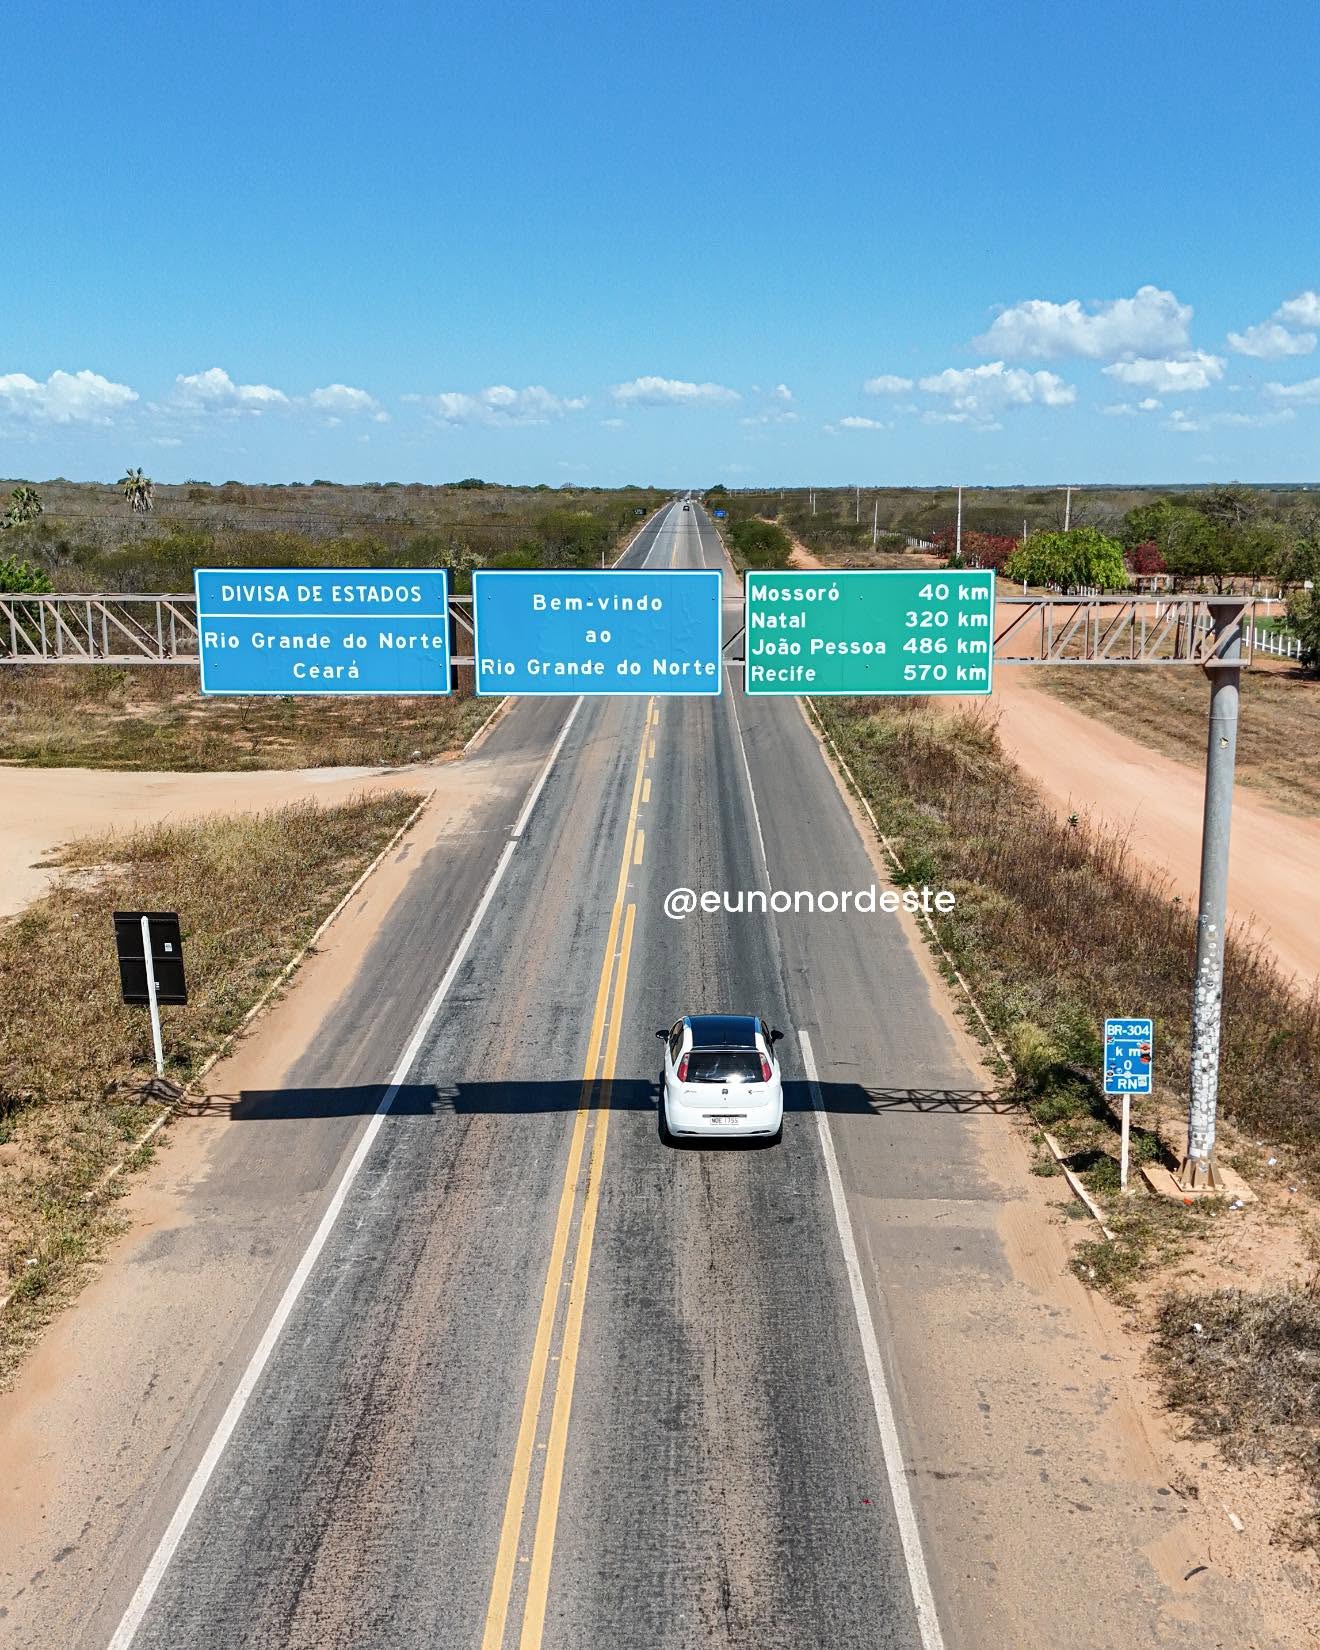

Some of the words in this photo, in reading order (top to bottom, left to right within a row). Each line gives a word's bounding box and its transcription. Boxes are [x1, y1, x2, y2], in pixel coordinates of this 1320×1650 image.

[221, 585, 289, 602] DIVISA
[297, 585, 323, 602] DE
[332, 585, 422, 603] ESTADOS
[751, 582, 840, 602] Mossoró
[918, 583, 950, 601] 40
[958, 584, 989, 600] km
[533, 594, 663, 611] Bem-vindo
[751, 612, 806, 629] Natal
[904, 611, 949, 628] 320
[957, 611, 988, 627] km
[204, 631, 240, 649] Rio
[251, 632, 331, 649] Grande
[343, 633, 367, 649] do
[379, 632, 443, 649] Norte
[585, 629, 612, 643] ao
[751, 638, 801, 655] João
[810, 638, 886, 655] Pessoa
[902, 637, 948, 654] 486
[957, 637, 987, 654] km
[293, 659, 359, 679] Ceará
[481, 658, 516, 676] Rio
[527, 659, 605, 676] Grande
[616, 659, 641, 676] do
[653, 659, 716, 676] Norte
[751, 664, 817, 682] Recife
[903, 664, 948, 681] 570
[956, 664, 987, 681] km
[1107, 1025, 1150, 1036] BR-304
[1123, 1060, 1133, 1071] 0
[1117, 1079, 1138, 1090] RN
